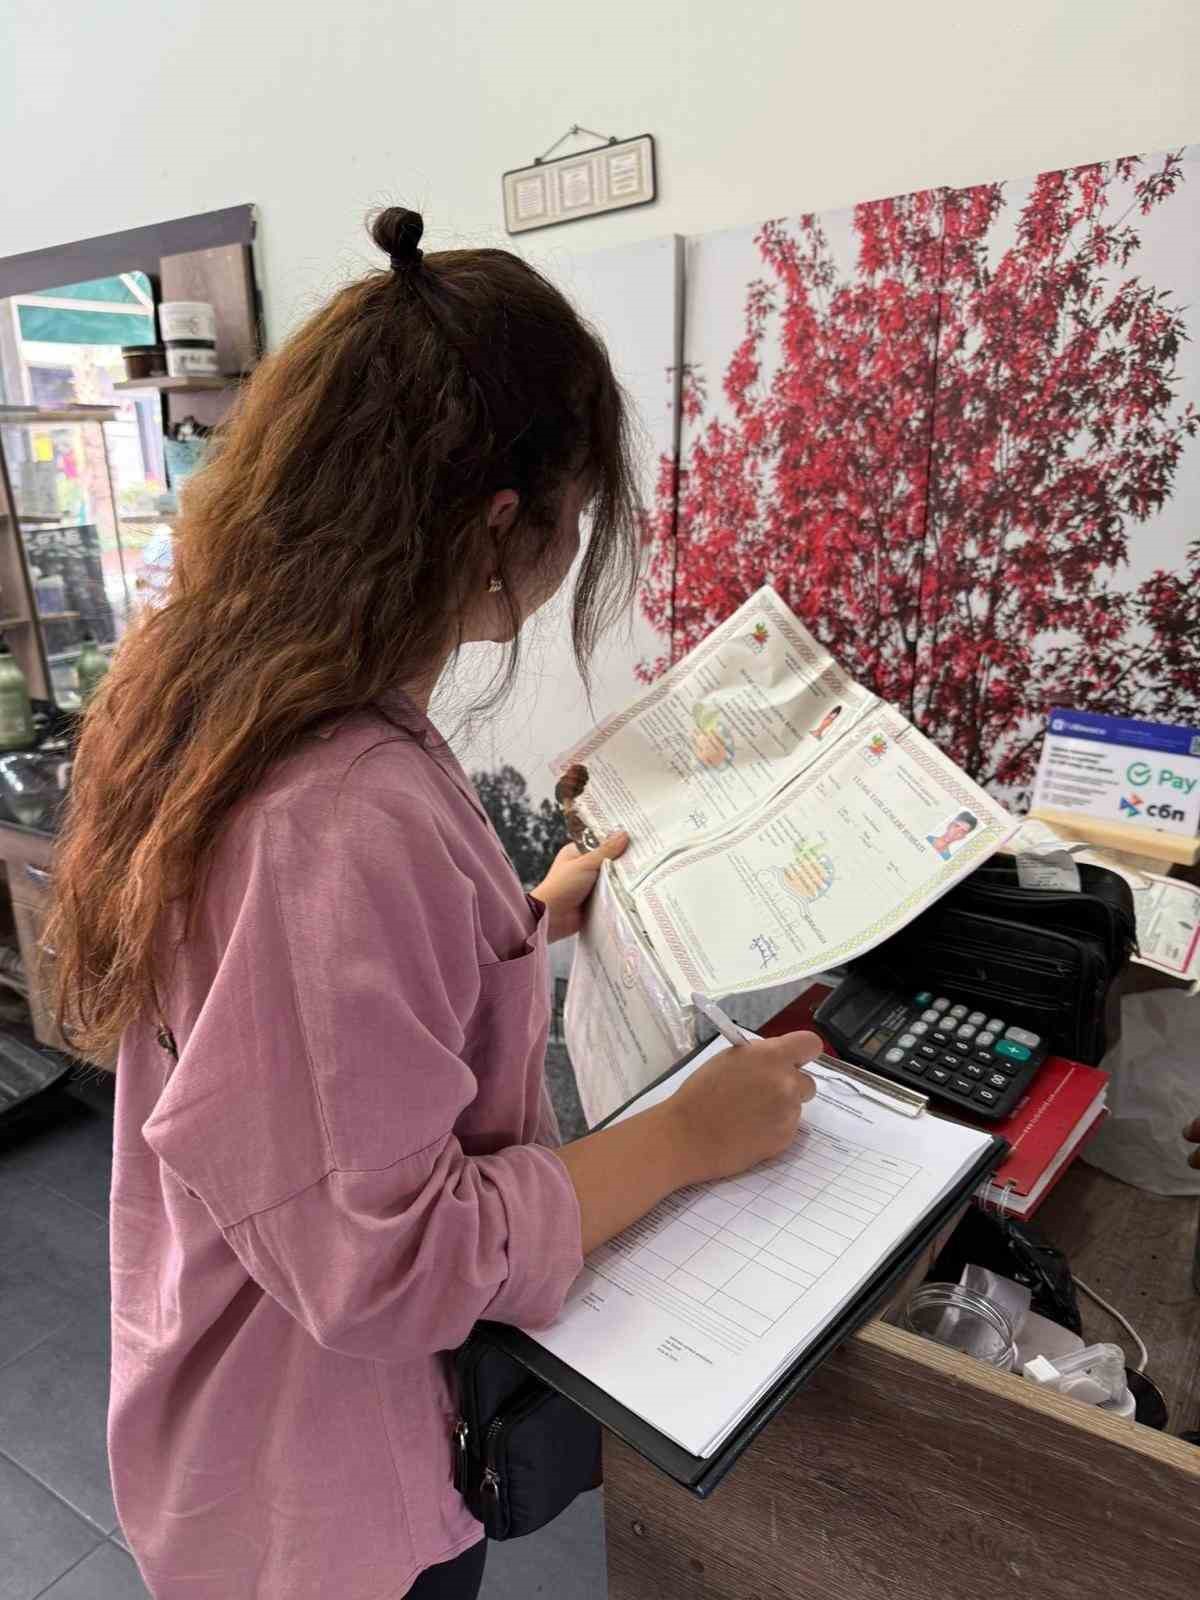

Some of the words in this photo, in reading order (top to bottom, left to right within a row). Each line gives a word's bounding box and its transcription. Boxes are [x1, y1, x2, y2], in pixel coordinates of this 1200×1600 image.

[1157, 769, 1198, 795] Pay
[967, 1065, 980, 1074] 2
[980, 1090, 993, 1099] 0
[990, 1074, 1006, 1085] 00
